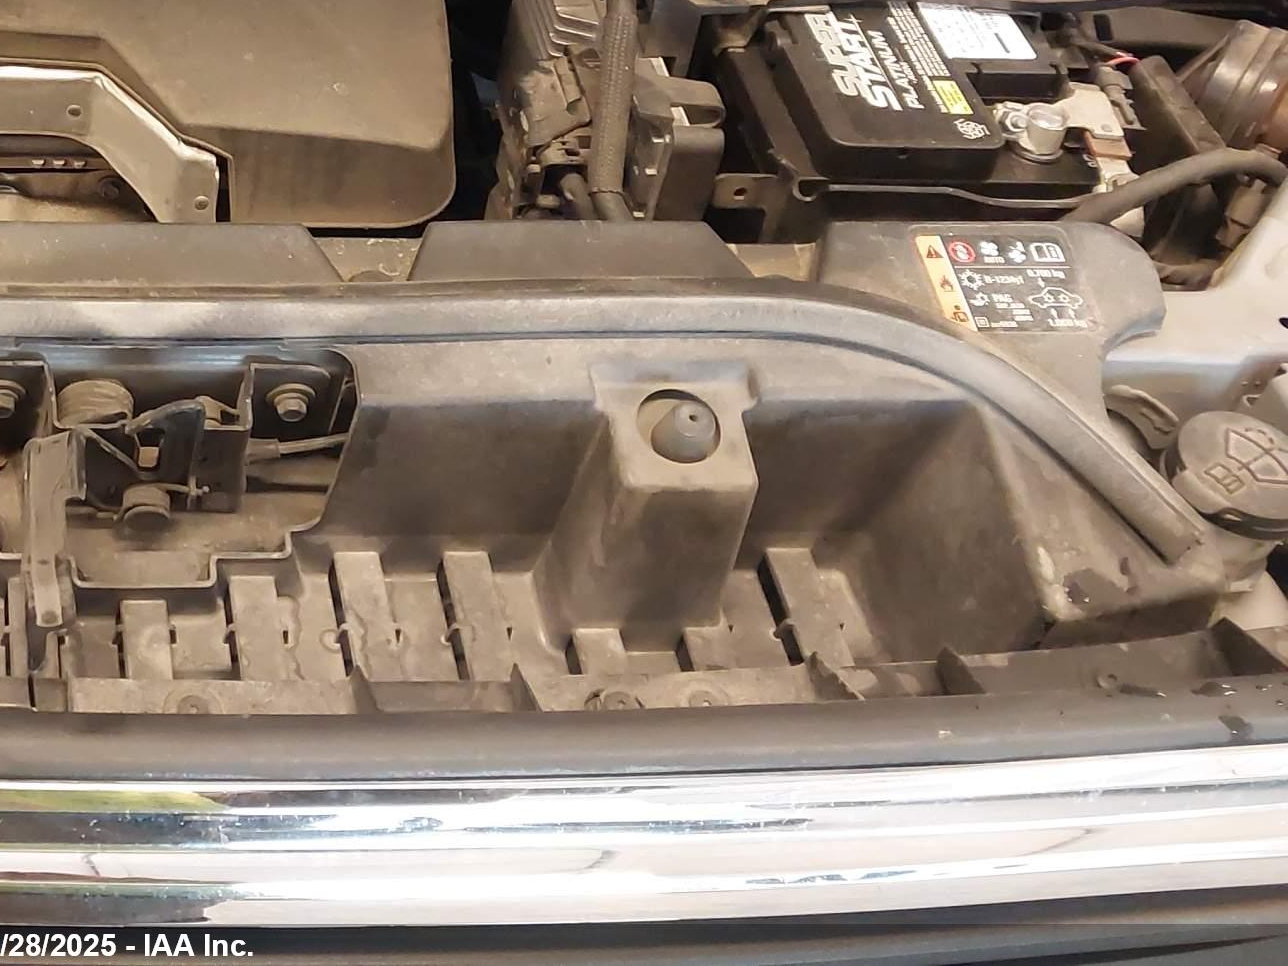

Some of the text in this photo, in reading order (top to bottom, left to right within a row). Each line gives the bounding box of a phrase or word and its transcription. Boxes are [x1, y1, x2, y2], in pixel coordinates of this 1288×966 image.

[804, 12, 859, 96] SUPER
[828, 10, 904, 111] START
[867, 30, 925, 110] PLATINUM
